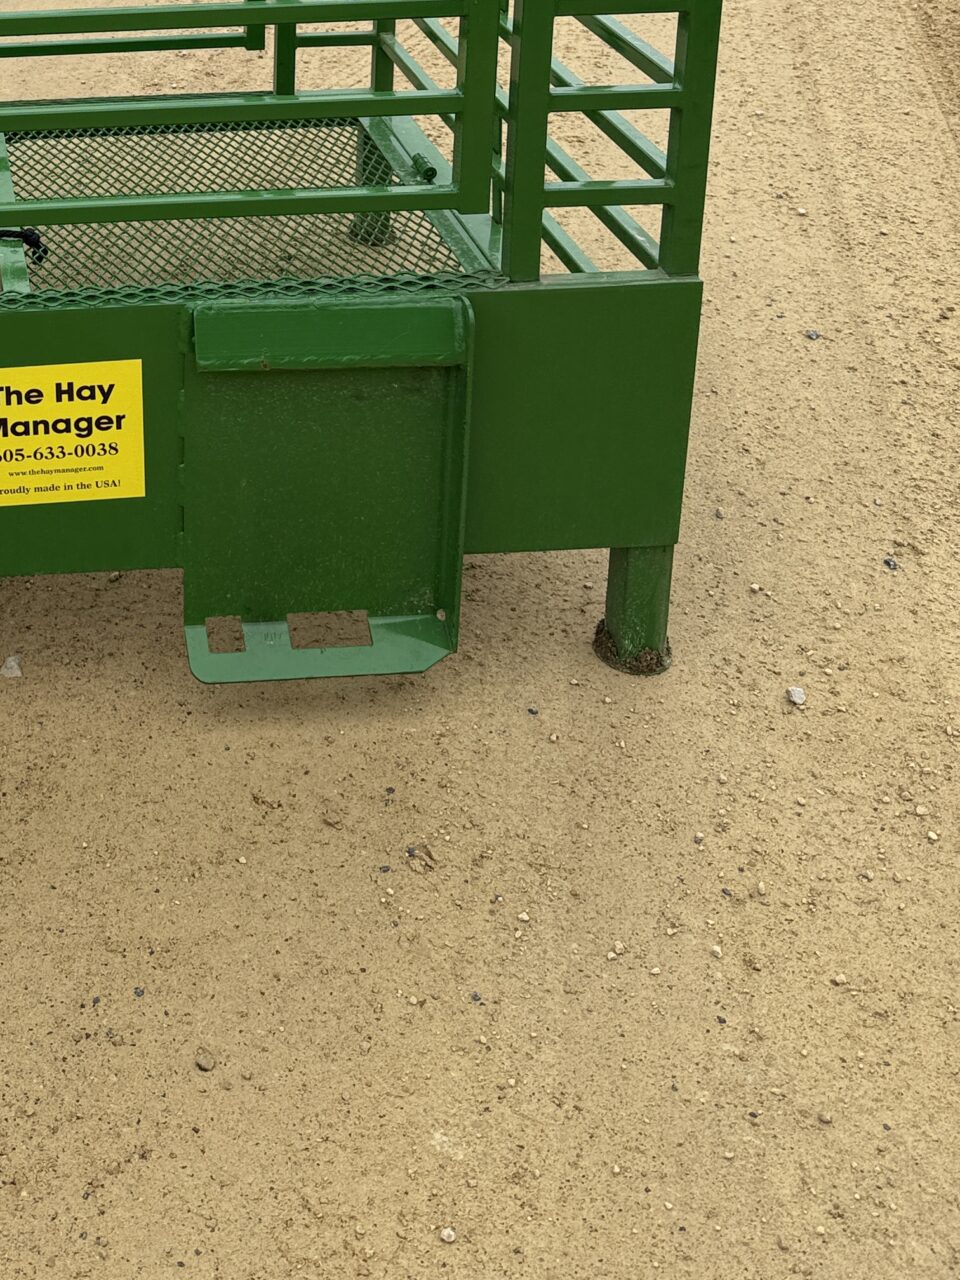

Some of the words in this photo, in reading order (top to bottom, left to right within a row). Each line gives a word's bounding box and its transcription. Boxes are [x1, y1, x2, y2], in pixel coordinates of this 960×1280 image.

[54, 381, 116, 405] Hay
[8, 464, 105, 478] www.thehaymanager.com
[33, 483, 61, 493] made
[63, 482, 74, 492] in
[76, 481, 92, 491] the
[95, 479, 122, 489] USA!
